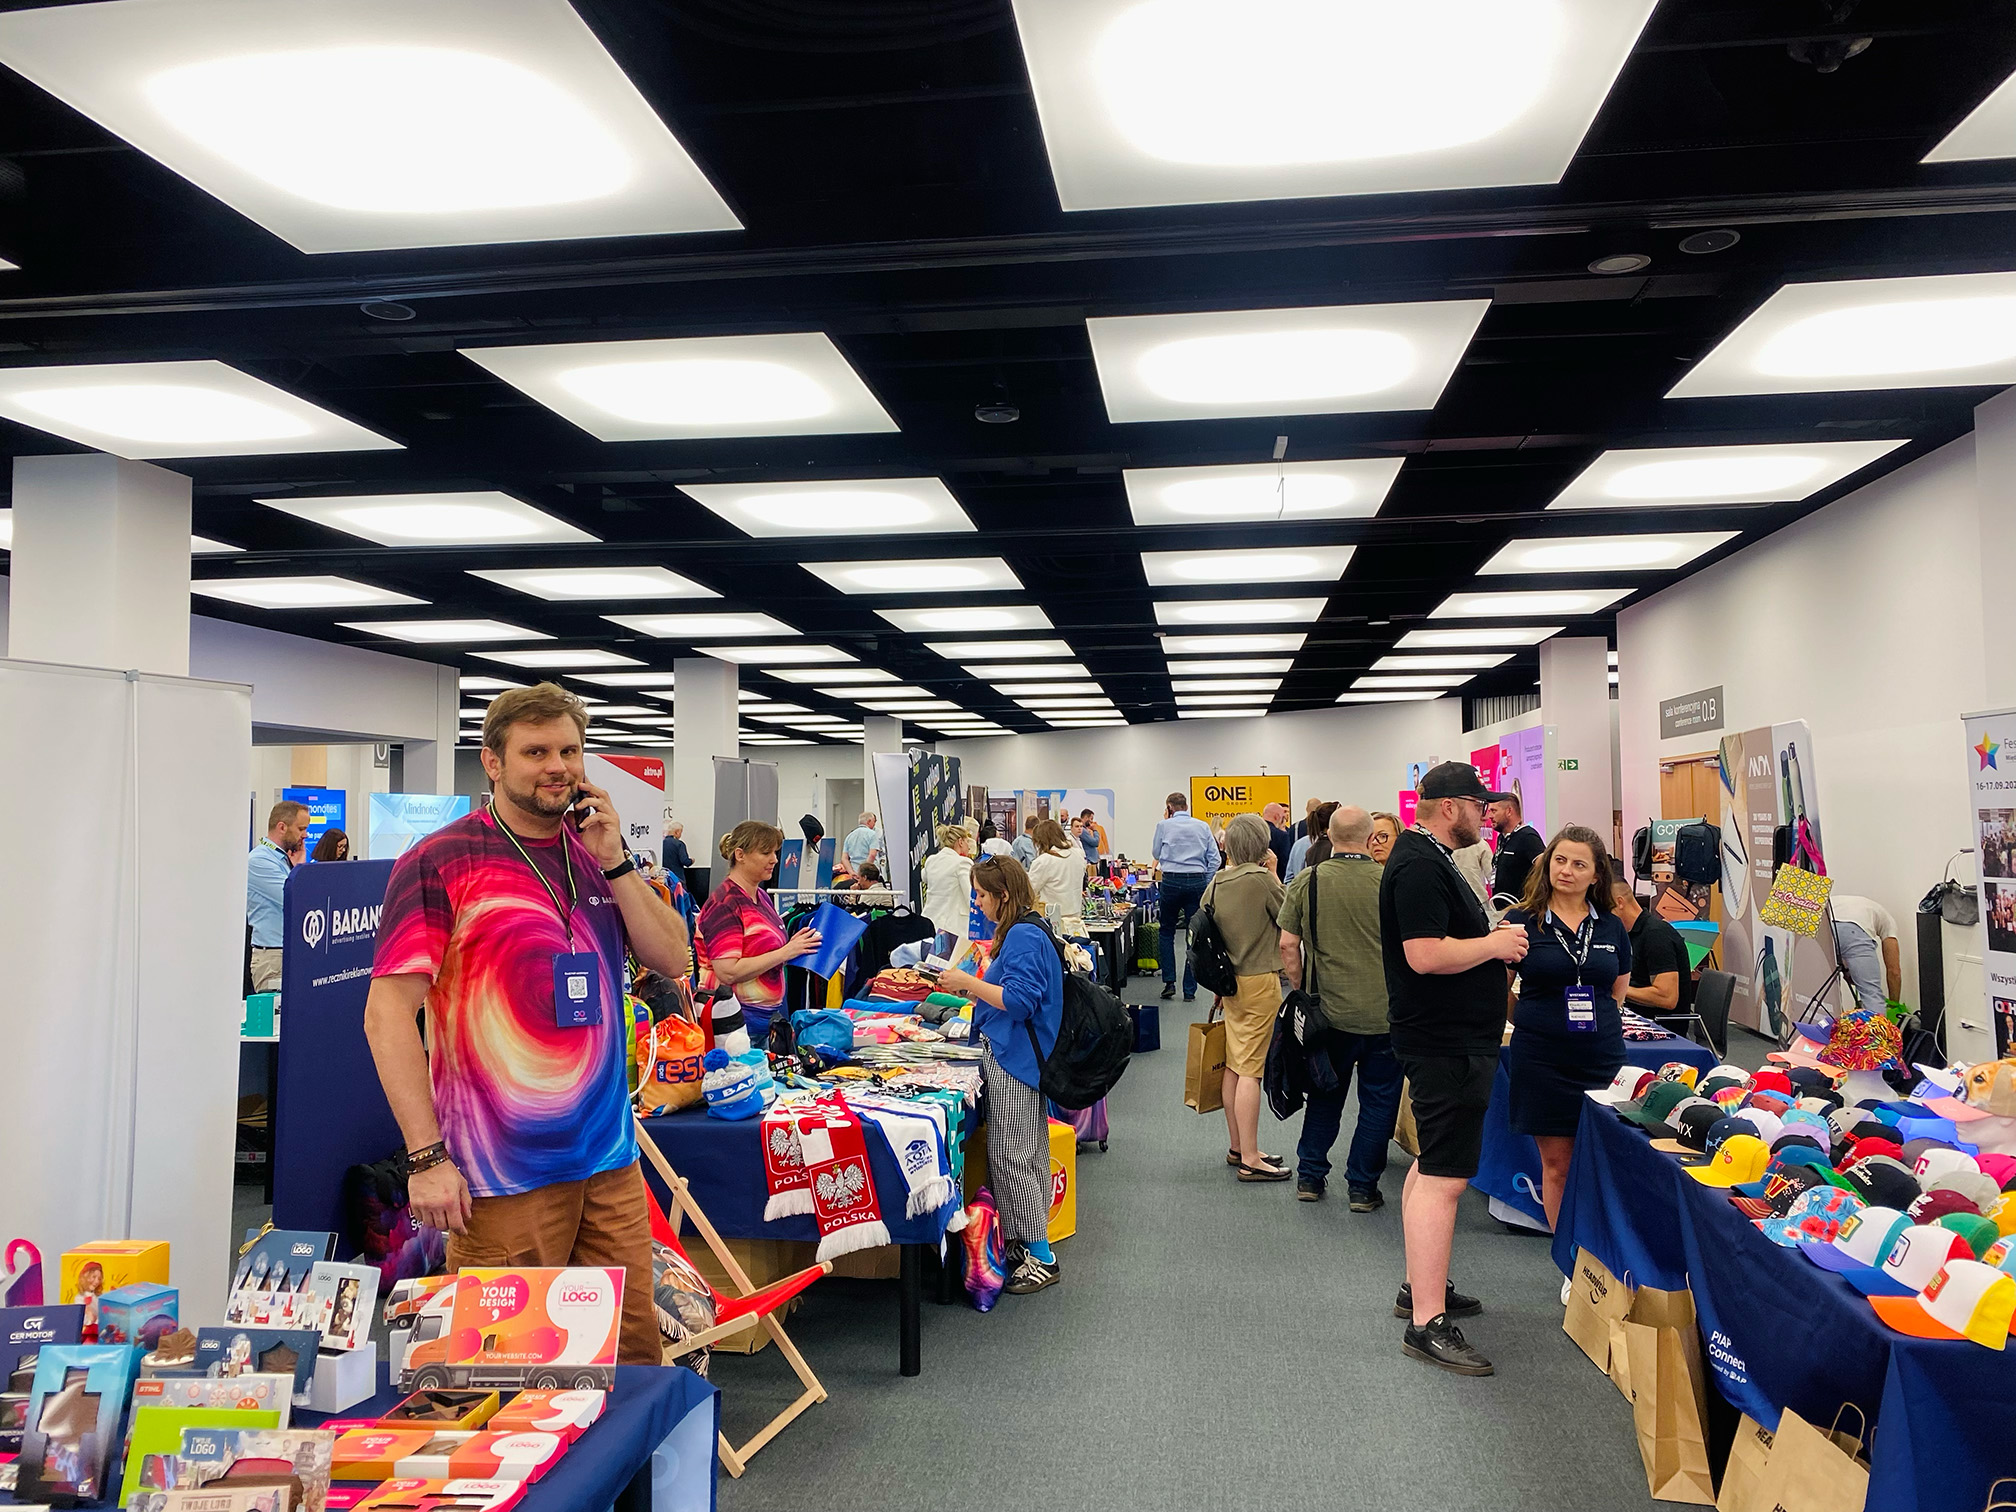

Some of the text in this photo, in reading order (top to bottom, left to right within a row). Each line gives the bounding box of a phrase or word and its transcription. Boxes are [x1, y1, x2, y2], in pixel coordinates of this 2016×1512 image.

[823, 1211, 877, 1232] POLSKA
[481, 1286, 516, 1298] YOUR
[561, 1291, 599, 1302] LOGO
[479, 1298, 516, 1307] DESIGN
[25, 1330, 53, 1340] MOTOR
[1711, 1330, 1732, 1349] PIAP
[1708, 1343, 1746, 1373] Connect
[190, 1443, 217, 1456] LOGO
